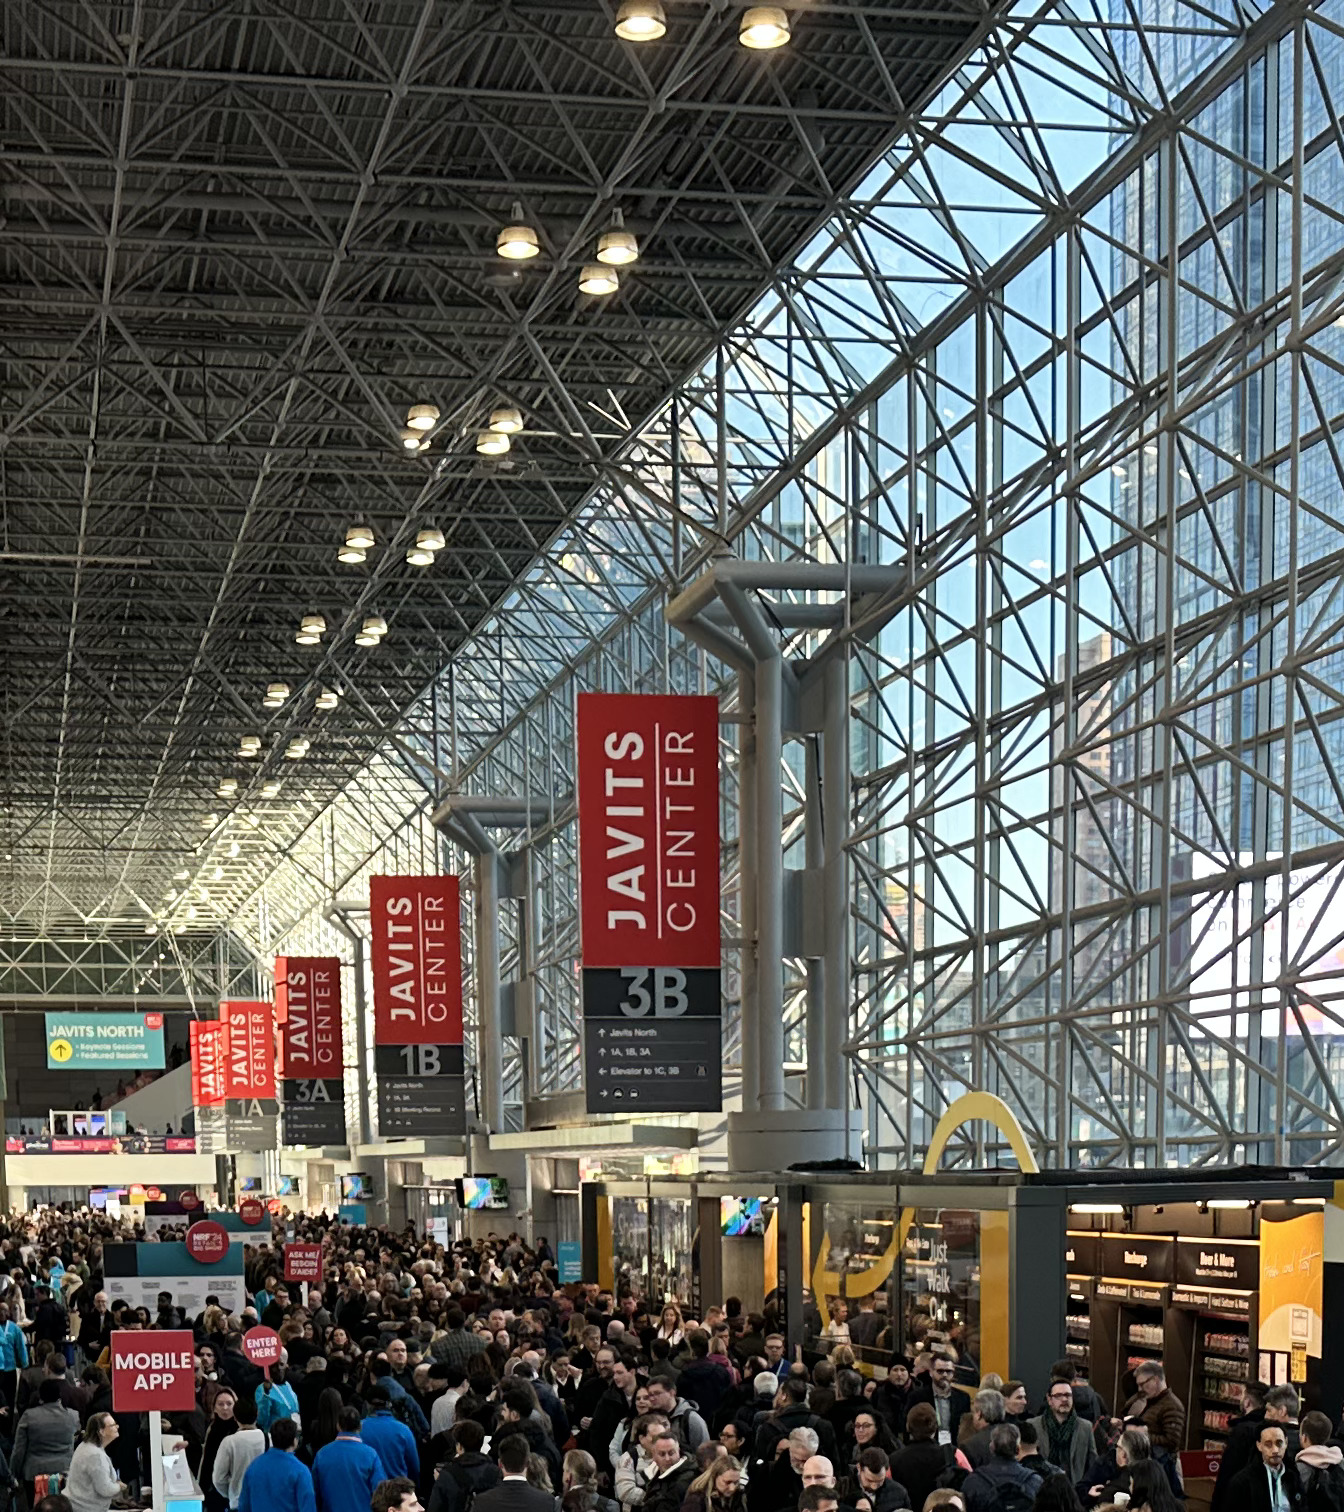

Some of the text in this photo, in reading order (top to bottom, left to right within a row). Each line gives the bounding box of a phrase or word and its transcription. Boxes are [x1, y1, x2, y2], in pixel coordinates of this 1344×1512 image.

[604, 731, 647, 930] JAVITS
[664, 731, 697, 932] CENTER
[386, 897, 417, 1022] JAVITS
[424, 897, 448, 1022] CENTER
[620, 967, 689, 1018] 3B
[287, 971, 310, 1063] JAVITS
[315, 971, 333, 1063] CENTER
[49, 1026, 144, 1038] JAVITS NORTH
[609, 1028, 658, 1037] Javits North
[80, 1051, 114, 1059] Featured
[112, 1042, 145, 1050] Sessions
[230, 1013, 249, 1086] JAVITS
[252, 1013, 267, 1087] CENTER
[199, 1033, 215, 1095] JAVITS
[400, 1044, 441, 1076] 1B
[644, 1067, 653, 1075] to
[295, 1079, 331, 1103] 3A
[237, 1100, 264, 1118] 1A
[928, 1237, 948, 1264] Just
[1219, 1252, 1235, 1268] More
[927, 1267, 950, 1294] Walk
[246, 1336, 278, 1349] ENTER
[251, 1347, 277, 1359] HERE
[114, 1352, 192, 1370] MOBILE
[133, 1373, 175, 1391] APP
